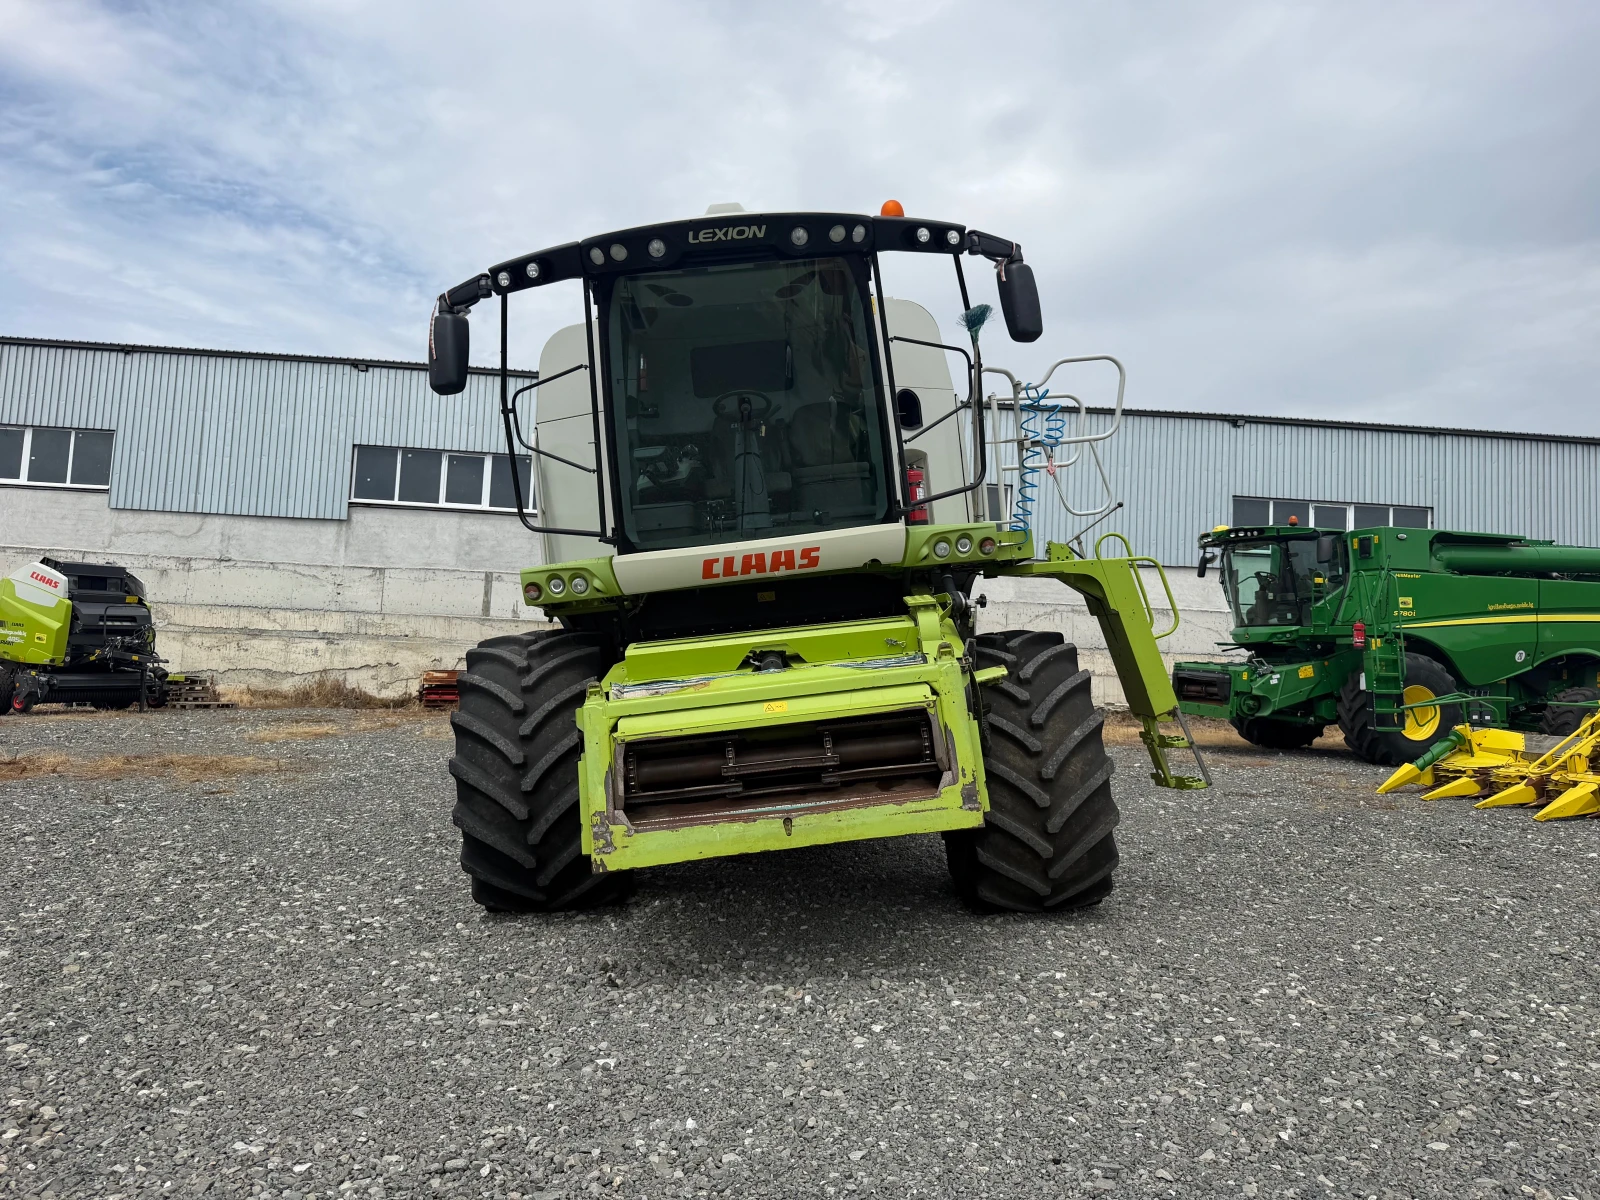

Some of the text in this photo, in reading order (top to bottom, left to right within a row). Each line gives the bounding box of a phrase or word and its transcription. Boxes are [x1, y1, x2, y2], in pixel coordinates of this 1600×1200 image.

[688, 225, 767, 244] LEXION
[701, 546, 821, 580] CLAAS
[30, 570, 60, 589] CLAAS
